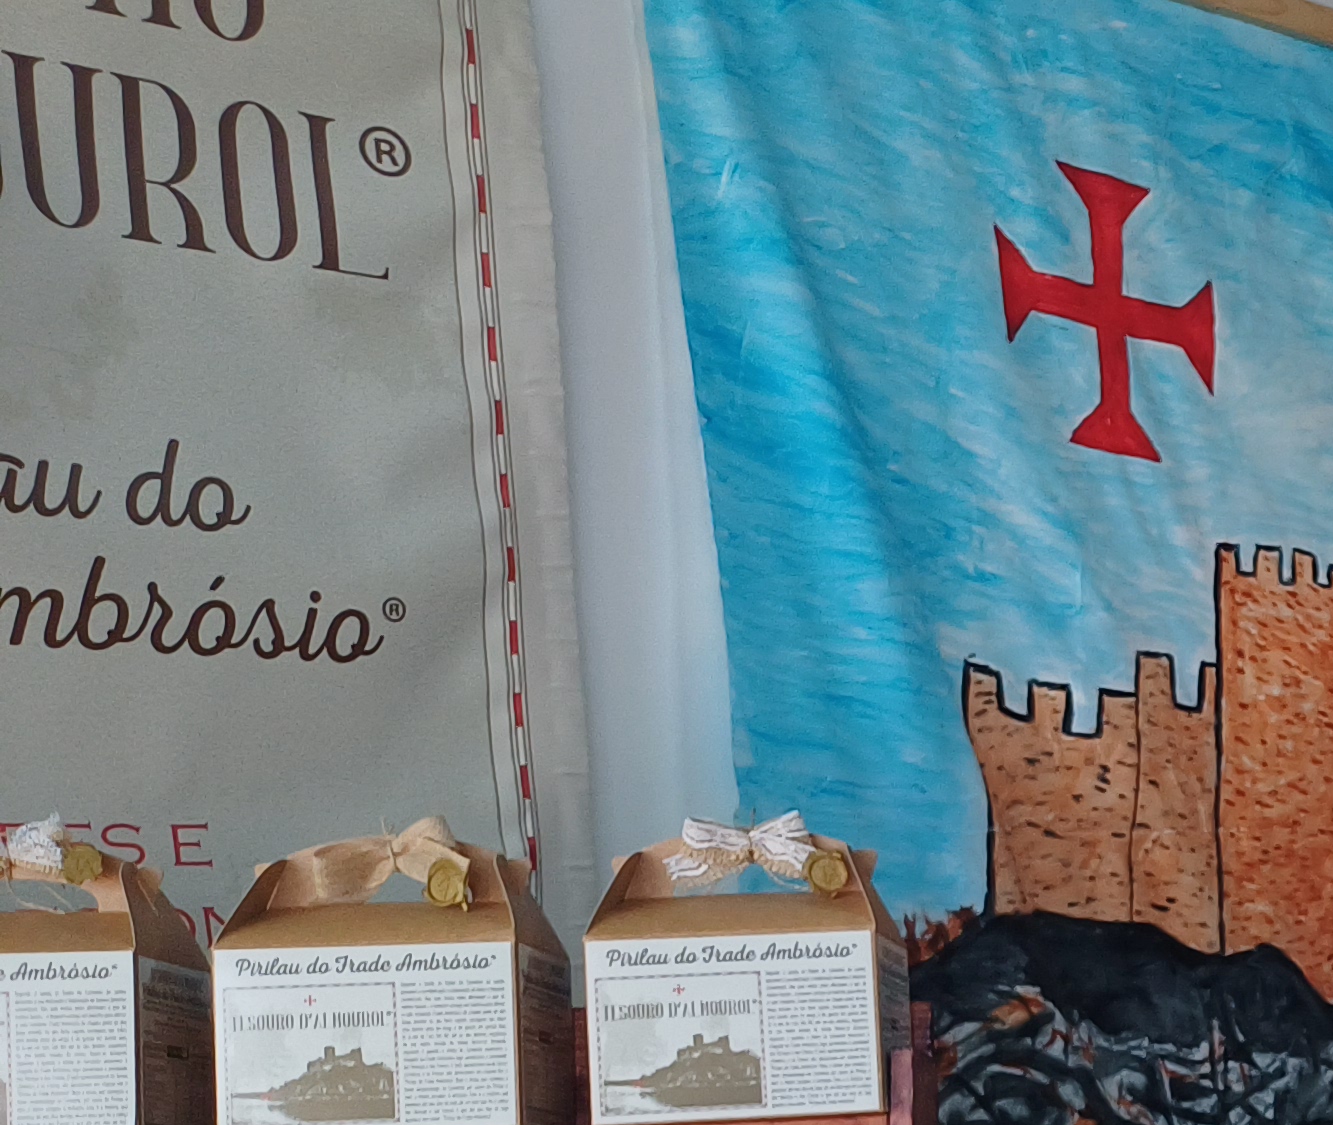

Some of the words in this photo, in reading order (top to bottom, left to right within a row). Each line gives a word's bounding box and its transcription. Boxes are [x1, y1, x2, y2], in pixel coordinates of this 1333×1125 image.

[0, 49, 412, 282] UROL®
[125, 438, 252, 532] do
[235, 957, 303, 977] Pirilau
[306, 955, 332, 975] do
[605, 947, 671, 968] Pirilau
[674, 945, 700, 965] do
